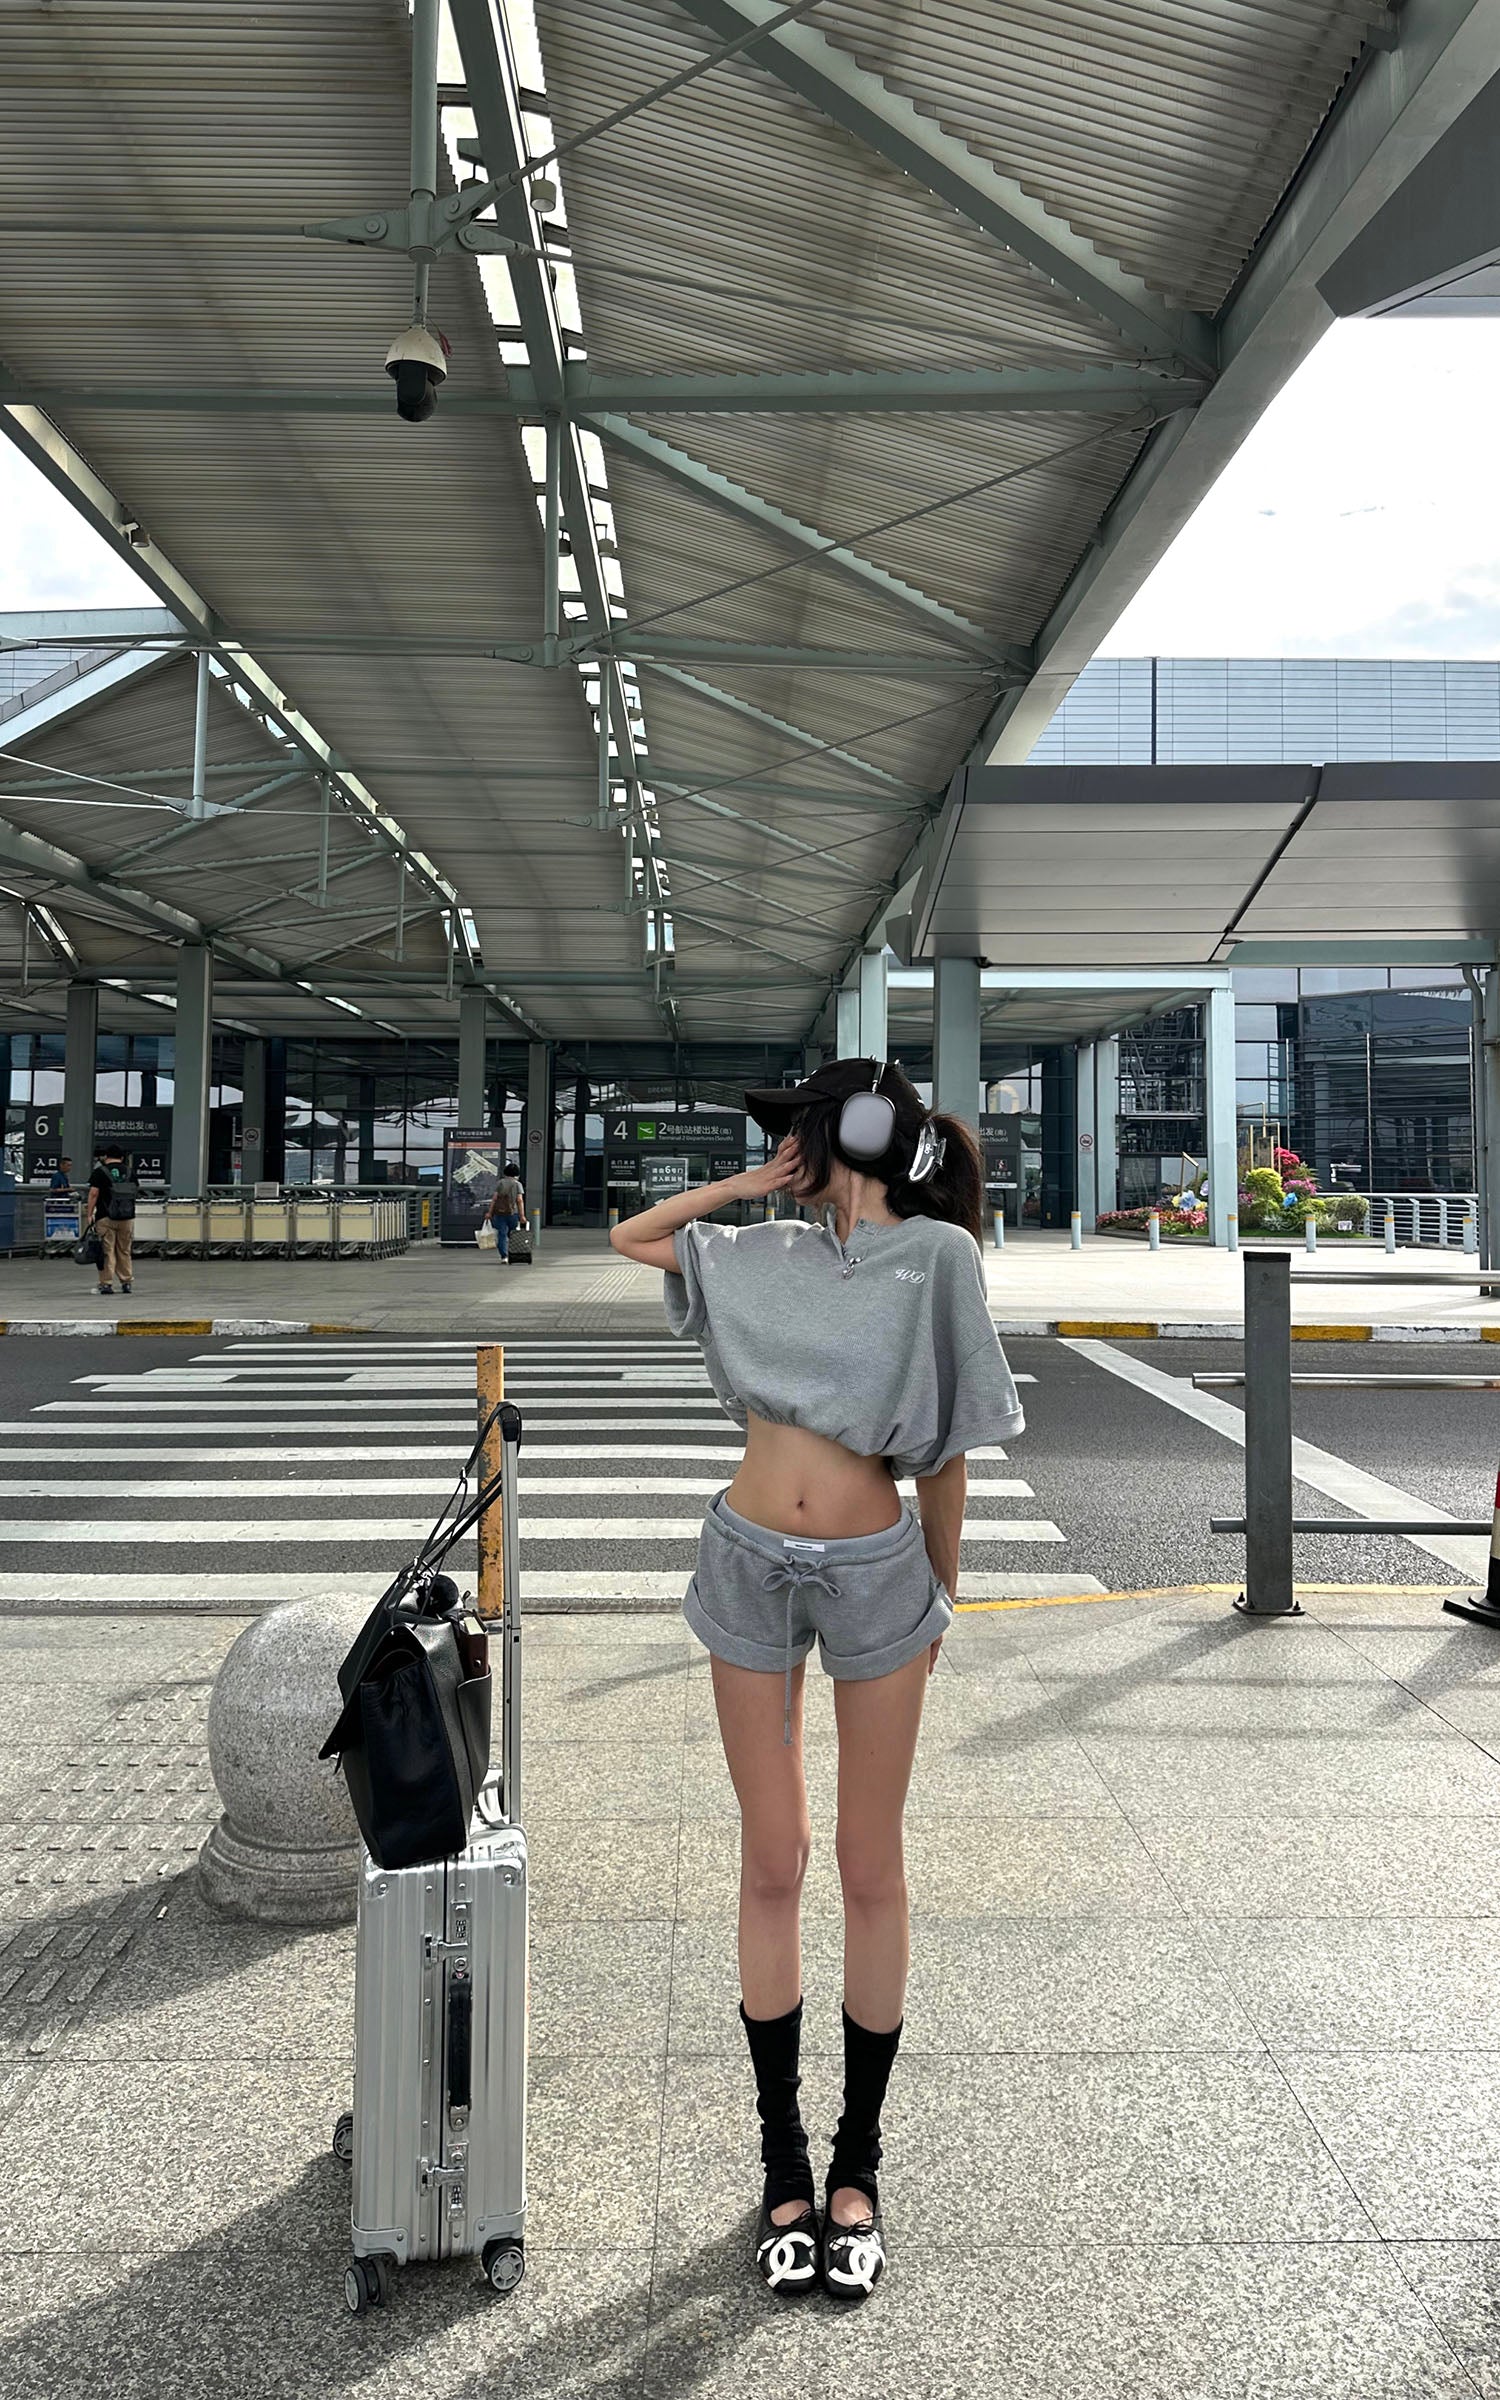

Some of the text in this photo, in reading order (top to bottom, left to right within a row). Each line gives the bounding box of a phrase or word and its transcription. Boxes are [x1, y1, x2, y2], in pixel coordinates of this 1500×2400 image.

[35, 1115, 49, 1136] 6
[613, 1120, 628, 1140] 4
[36, 1158, 57, 1167] 入口
[139, 1159, 160, 1167] 入口
